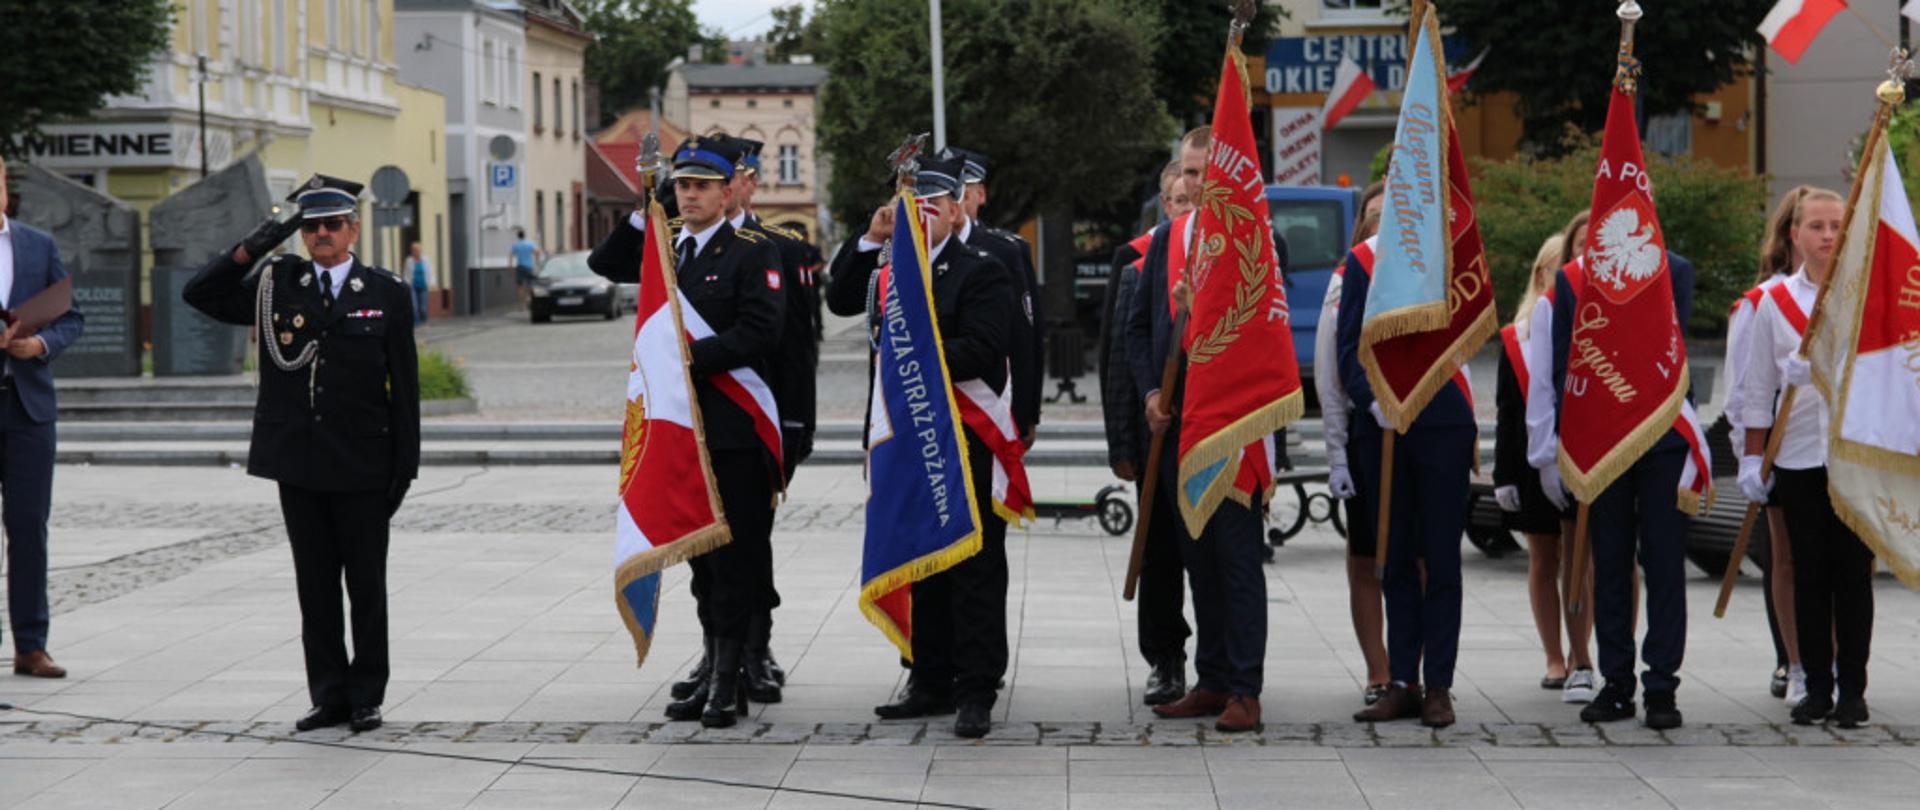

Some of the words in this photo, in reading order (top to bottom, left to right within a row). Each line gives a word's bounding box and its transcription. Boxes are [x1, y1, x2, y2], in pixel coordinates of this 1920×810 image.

[1266, 66, 1336, 93] OKIE
[1279, 112, 1313, 138] OKNA
[1573, 302, 1638, 403] Legionu
[898, 360, 936, 428] STRAŻ
[918, 427, 951, 528] POŻARNA
